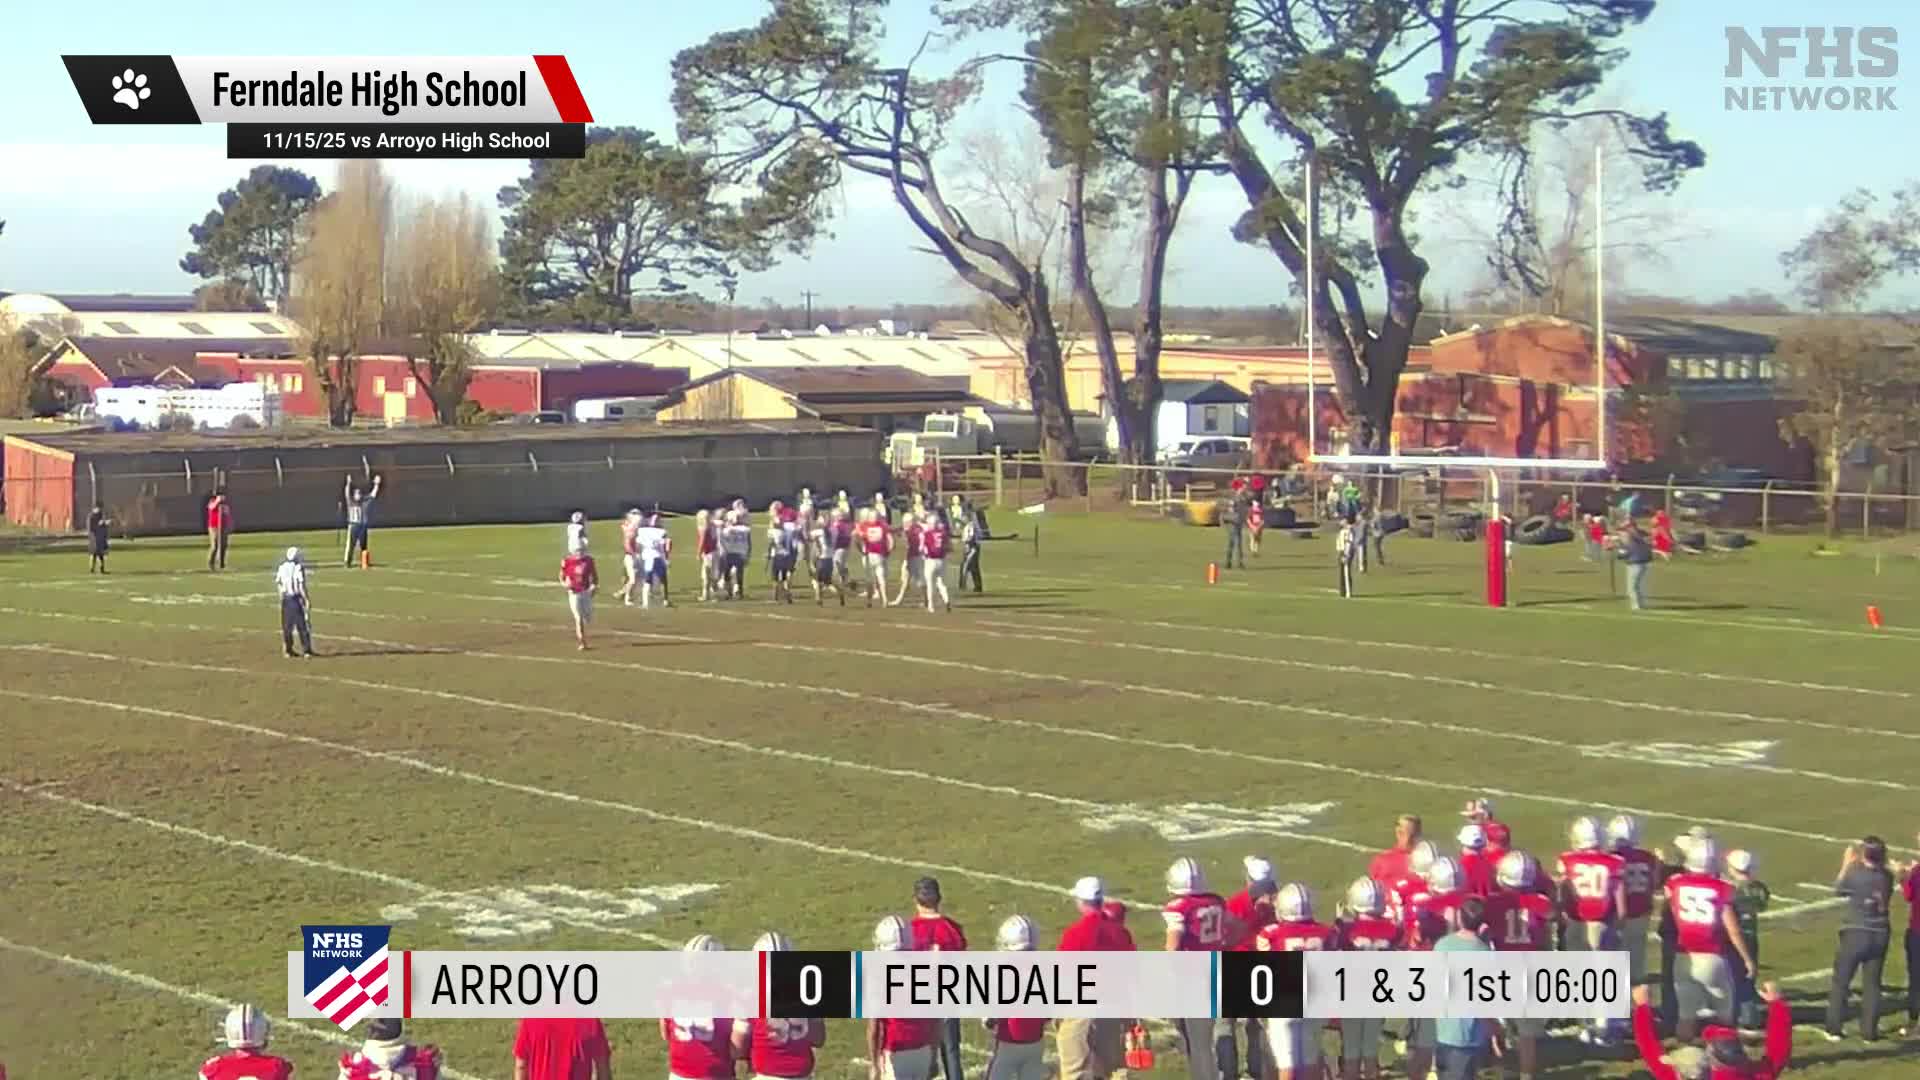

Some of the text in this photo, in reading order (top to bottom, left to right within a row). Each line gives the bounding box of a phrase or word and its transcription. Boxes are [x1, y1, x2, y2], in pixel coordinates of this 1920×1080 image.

[1574, 863, 1608, 898] 20
[1679, 885, 1718, 924] 55
[1505, 909, 1531, 944] 11
